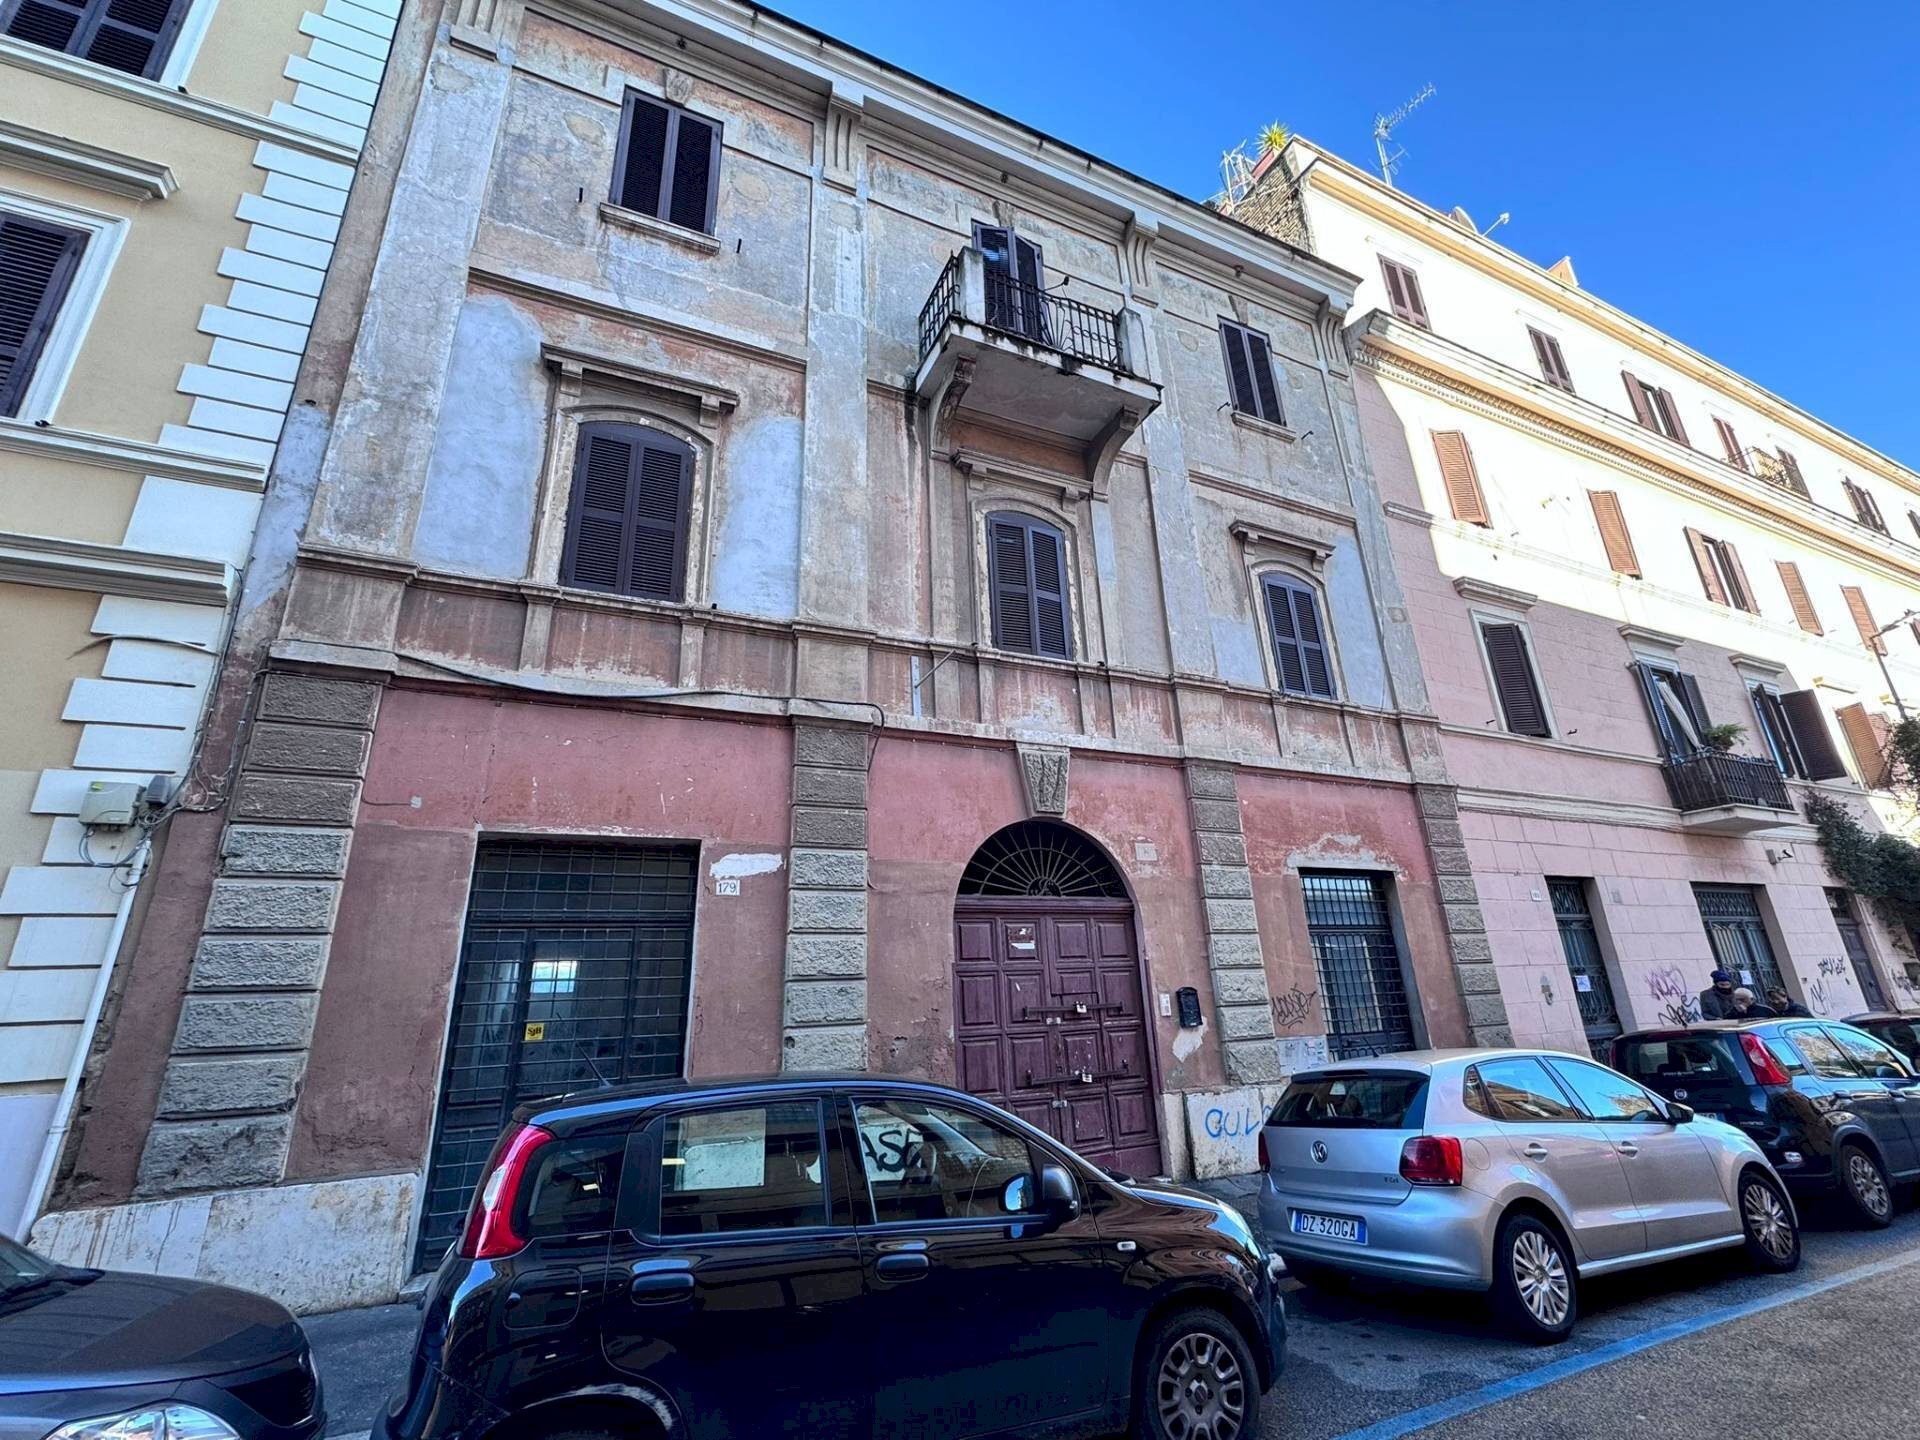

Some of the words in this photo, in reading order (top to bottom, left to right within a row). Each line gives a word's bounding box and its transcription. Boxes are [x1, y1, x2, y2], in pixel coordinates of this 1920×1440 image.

[719, 882, 737, 894] 179
[1302, 1214, 1316, 1232] DZ
[1319, 1217, 1356, 1239] 320GA
